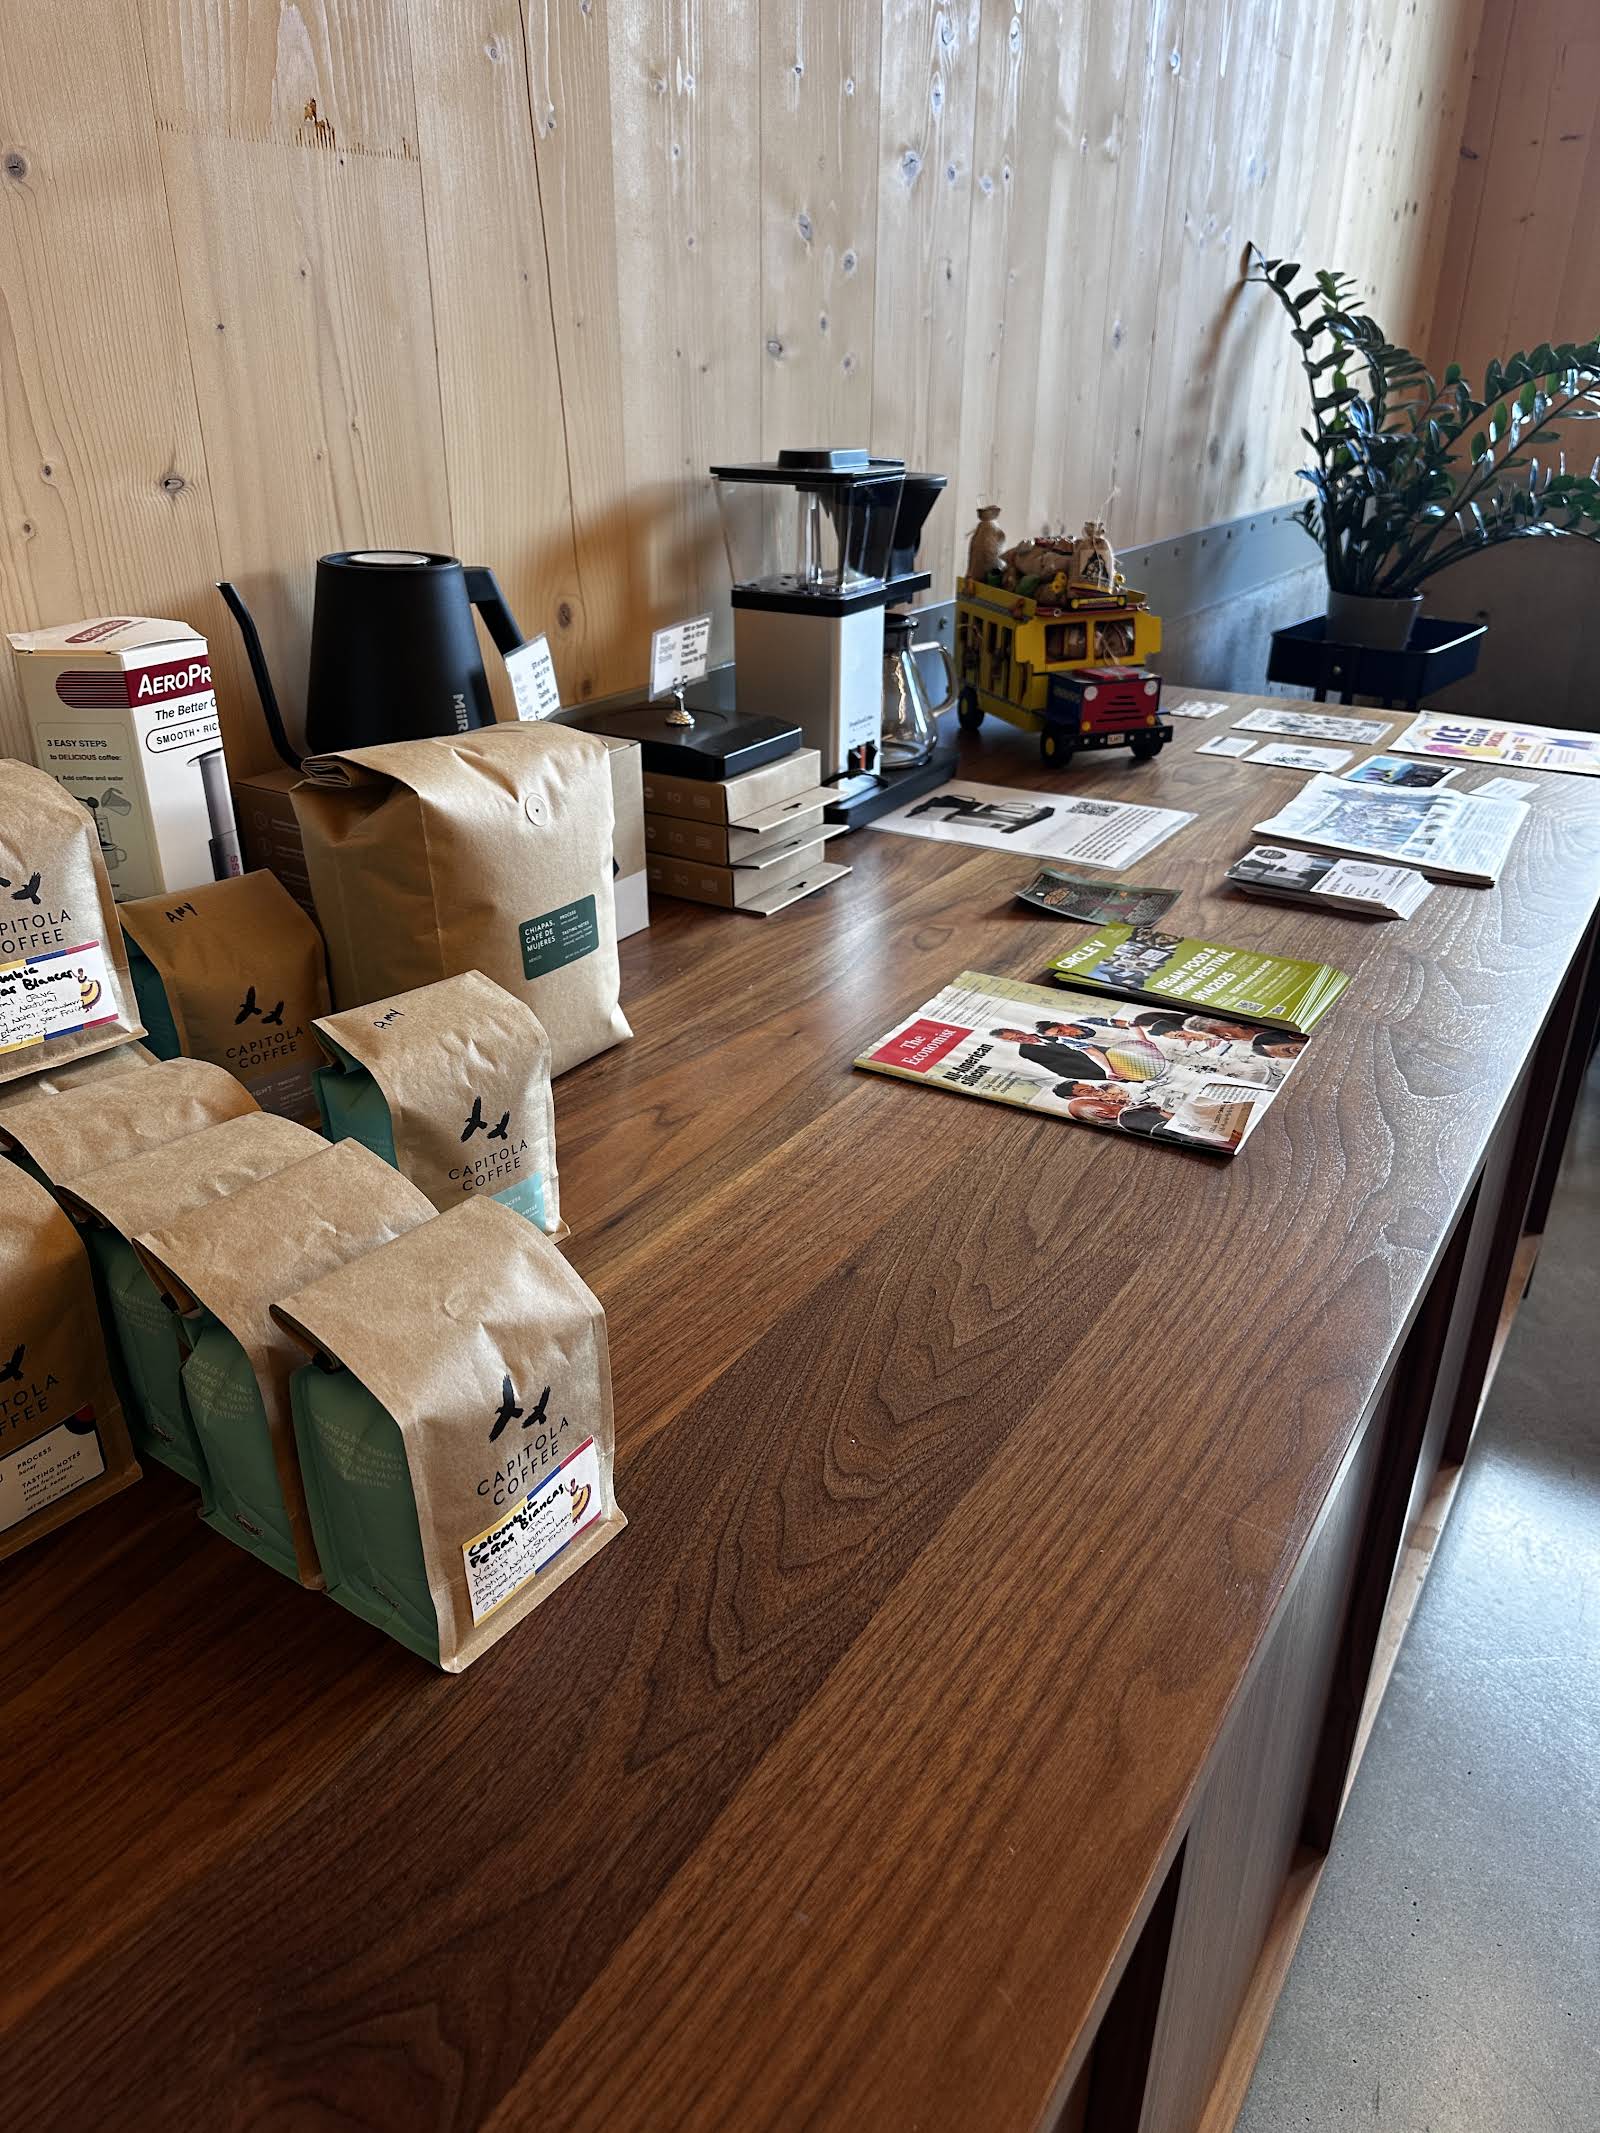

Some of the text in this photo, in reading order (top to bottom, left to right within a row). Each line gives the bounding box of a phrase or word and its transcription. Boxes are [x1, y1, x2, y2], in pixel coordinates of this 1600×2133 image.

[155, 709, 175, 721] The
[178, 701, 208, 716] Better
[452, 693, 469, 731] MiiR
[47, 739, 53, 747] 3
[79, 740, 107, 748] STEPS
[156, 728, 195, 745] SMOOTH
[1431, 725, 1473, 744] ICE
[526, 935, 556, 952] MUJERES
[544, 928, 554, 937] DE
[1056, 940, 1107, 969] CIRCLE V
[1152, 969, 1186, 990] VEGAN
[1183, 952, 1213, 973] FOOD
[1169, 974, 1202, 996] DRINK
[1196, 950, 1237, 981] FESTIVAL
[225, 1026, 304, 1059] CAPITOLA
[239, 1041, 298, 1069] COFFEE
[899, 1035, 927, 1051] The
[901, 1028, 956, 1066] Economist
[942, 1043, 995, 1082] All-American
[961, 1064, 992, 1087] silicon
[448, 1139, 528, 1180] CAPITOLA
[462, 1157, 521, 1191] COFFEE
[17, 1446, 53, 1470] PROCESS
[22, 1450, 81, 1488] TASTING NOTES
[477, 1417, 570, 1496] CAPITOLA
[493, 1440, 560, 1506] COFFEE
[519, 1483, 565, 1530] Blancas
[527, 1509, 554, 1533] Java
